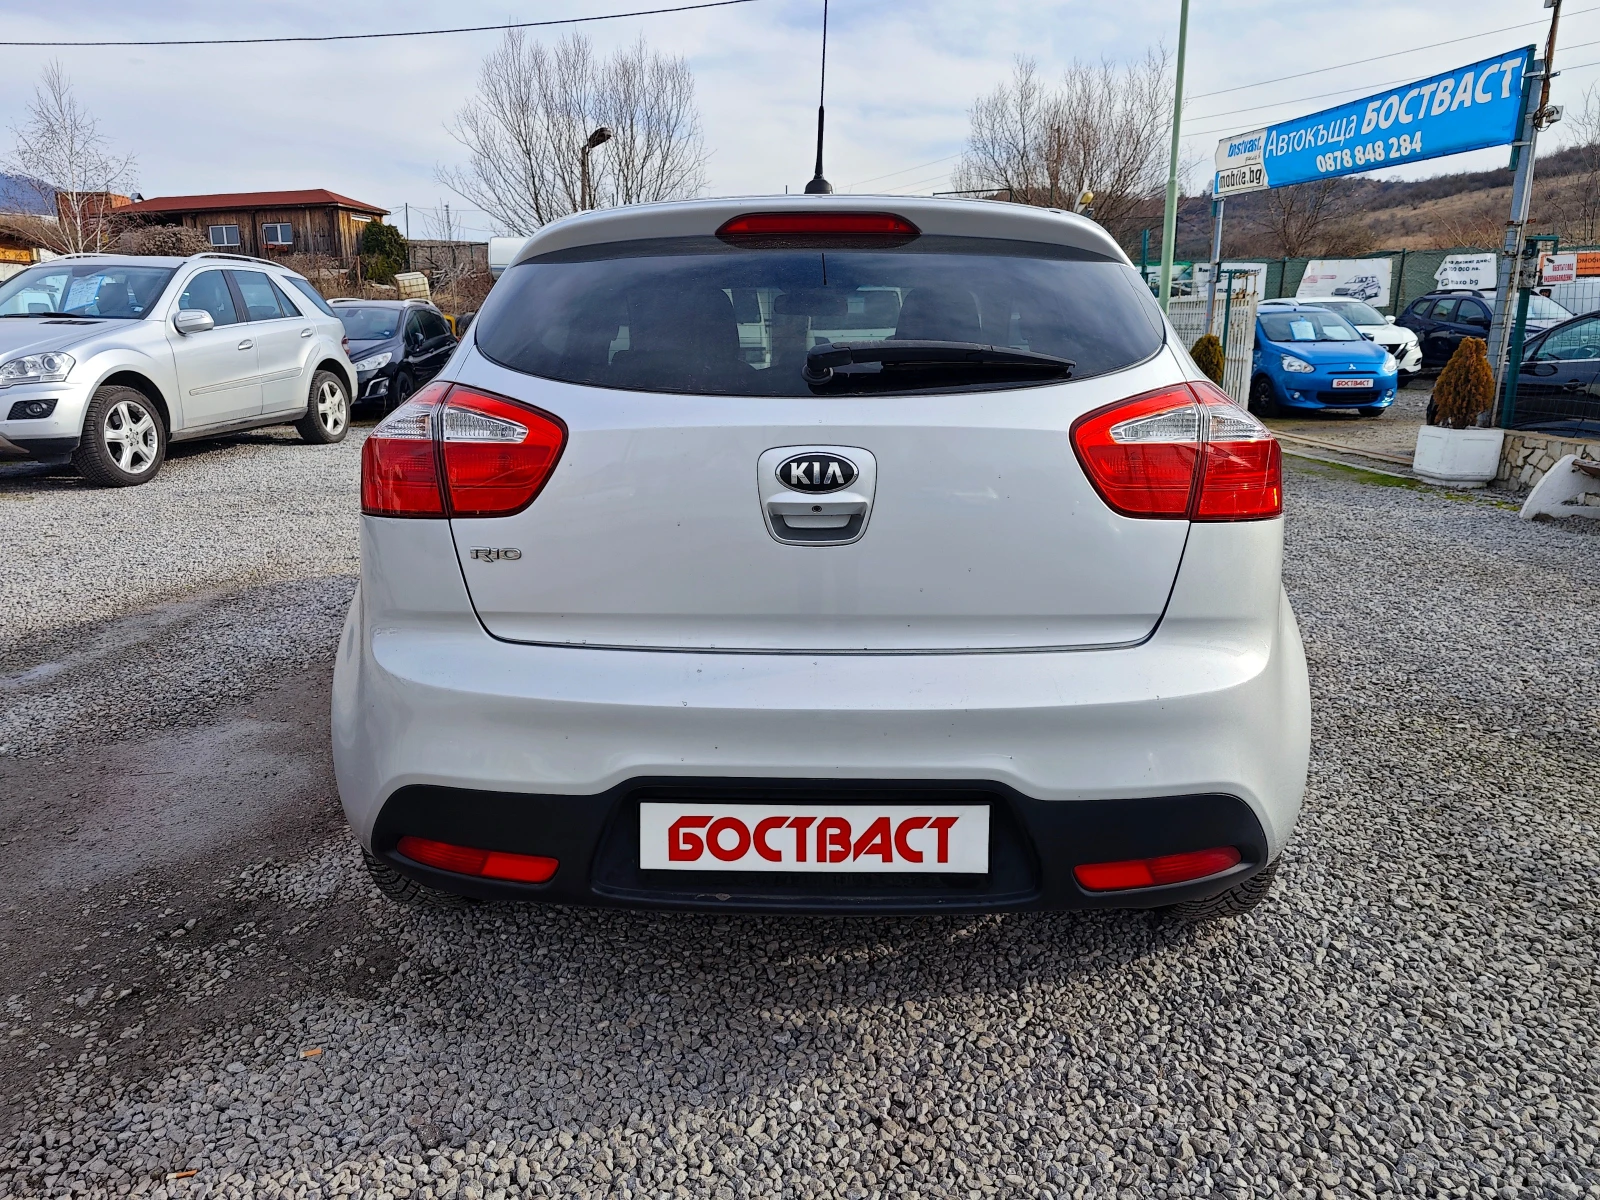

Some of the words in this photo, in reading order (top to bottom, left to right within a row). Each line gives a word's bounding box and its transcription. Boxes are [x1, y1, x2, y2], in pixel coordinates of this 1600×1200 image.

[1265, 115, 1357, 159] Автокъща
[1361, 57, 1522, 135] БОСТВАСТ
[1315, 151, 1352, 173] 0878
[1355, 141, 1385, 164] 848
[1389, 131, 1422, 159] 284
[1219, 167, 1262, 189] mobile.bg
[789, 461, 845, 485] KIA
[470, 545, 522, 563] RIO
[668, 815, 960, 863] БОСТВАСТ
